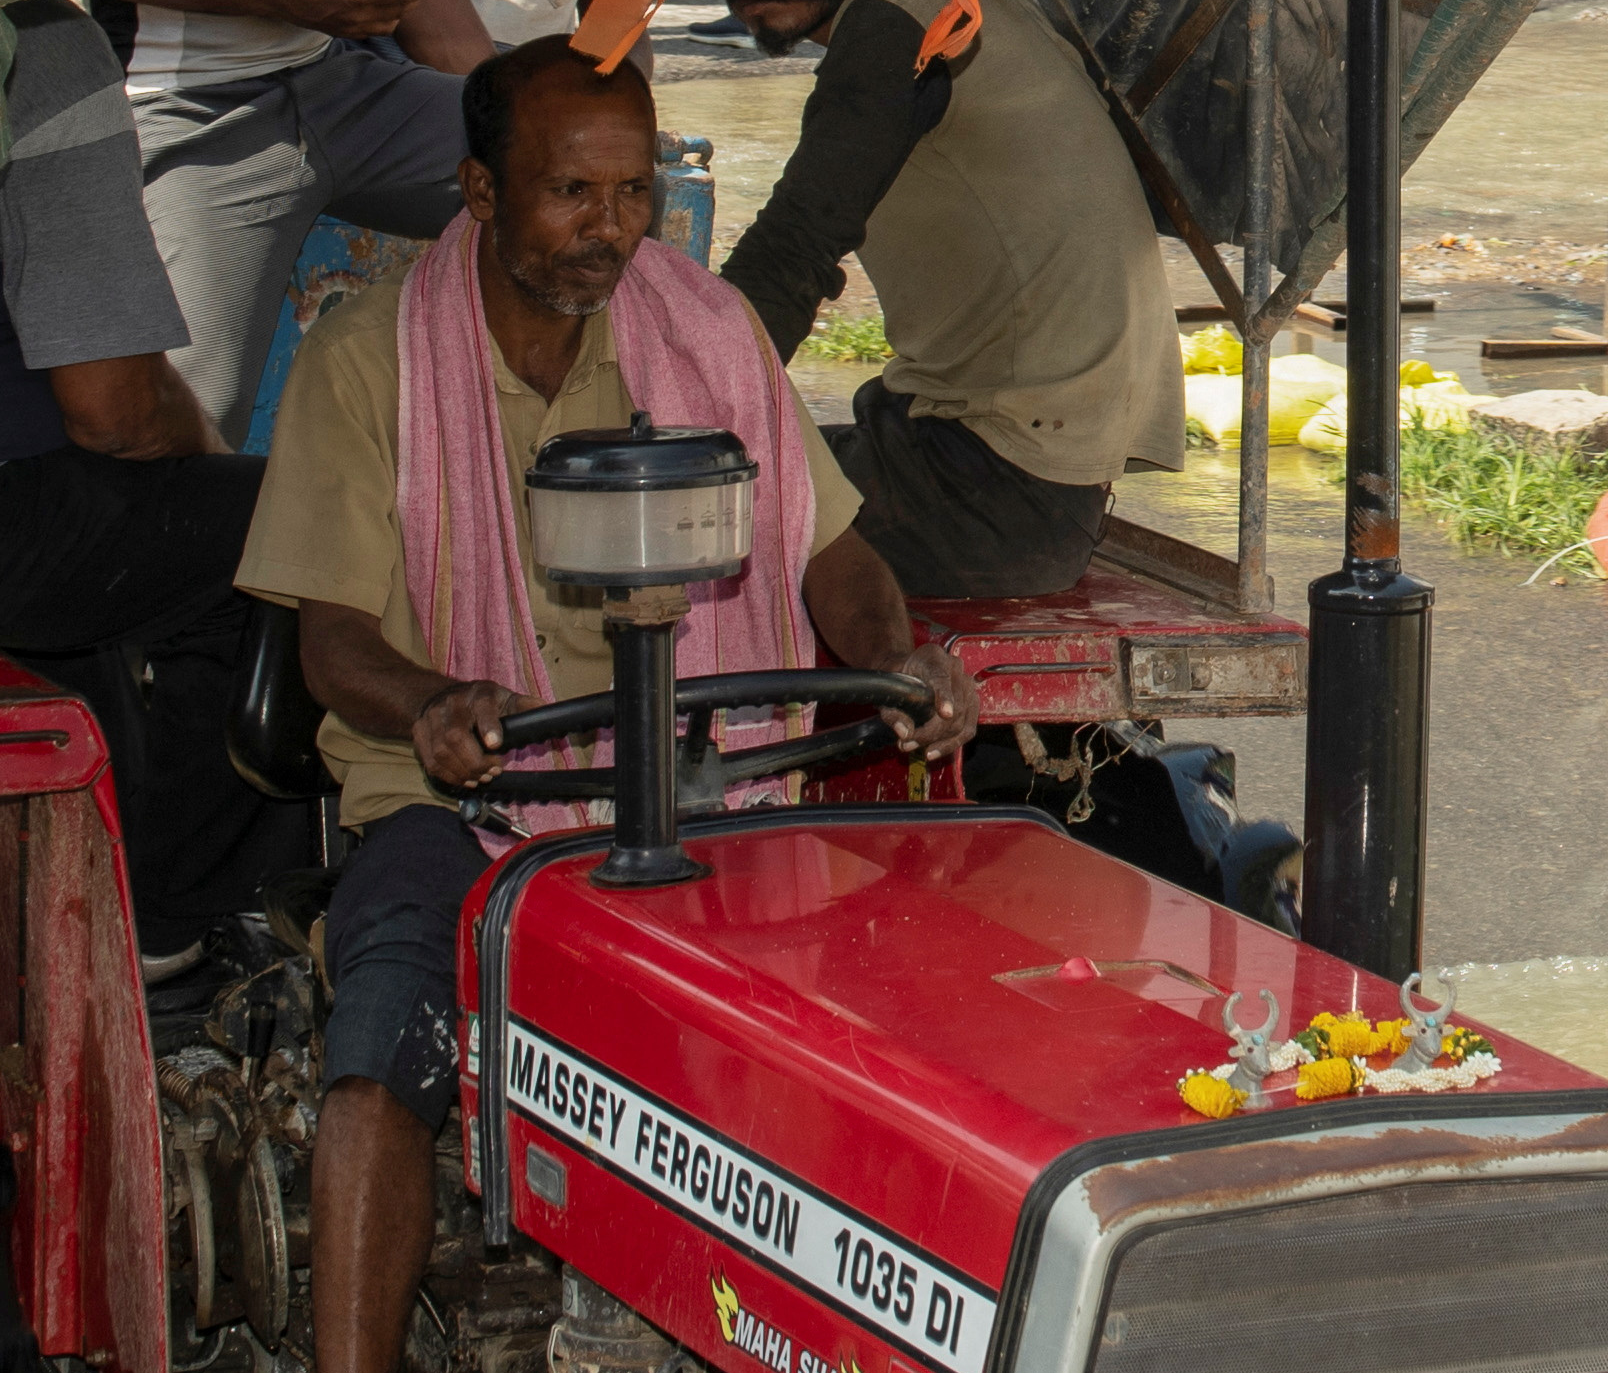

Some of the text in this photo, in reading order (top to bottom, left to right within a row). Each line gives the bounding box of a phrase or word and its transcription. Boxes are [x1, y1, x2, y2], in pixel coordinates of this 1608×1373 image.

[508, 1036, 965, 1355] MASSEY FERGUSON 1035 DI
